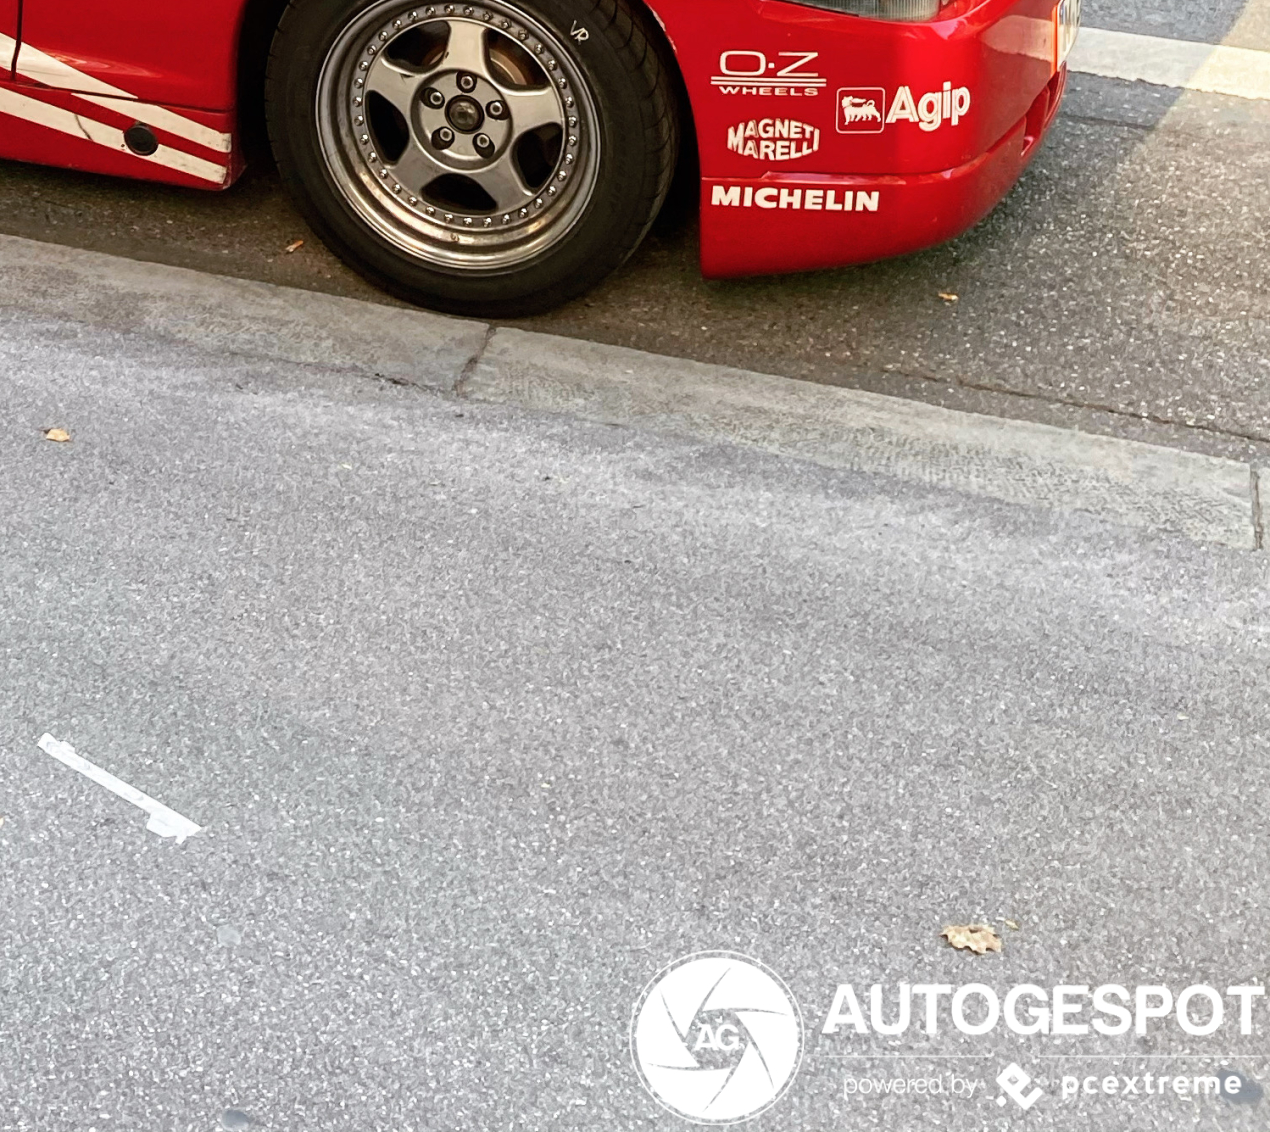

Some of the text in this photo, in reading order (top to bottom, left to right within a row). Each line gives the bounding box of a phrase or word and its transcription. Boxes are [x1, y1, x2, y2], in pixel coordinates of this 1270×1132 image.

[718, 86, 819, 96] WHEELS
[885, 81, 972, 132] Agip
[727, 118, 820, 142] MAGNETI
[727, 138, 820, 161] MARELLI
[710, 185, 880, 212] MICHELIN
